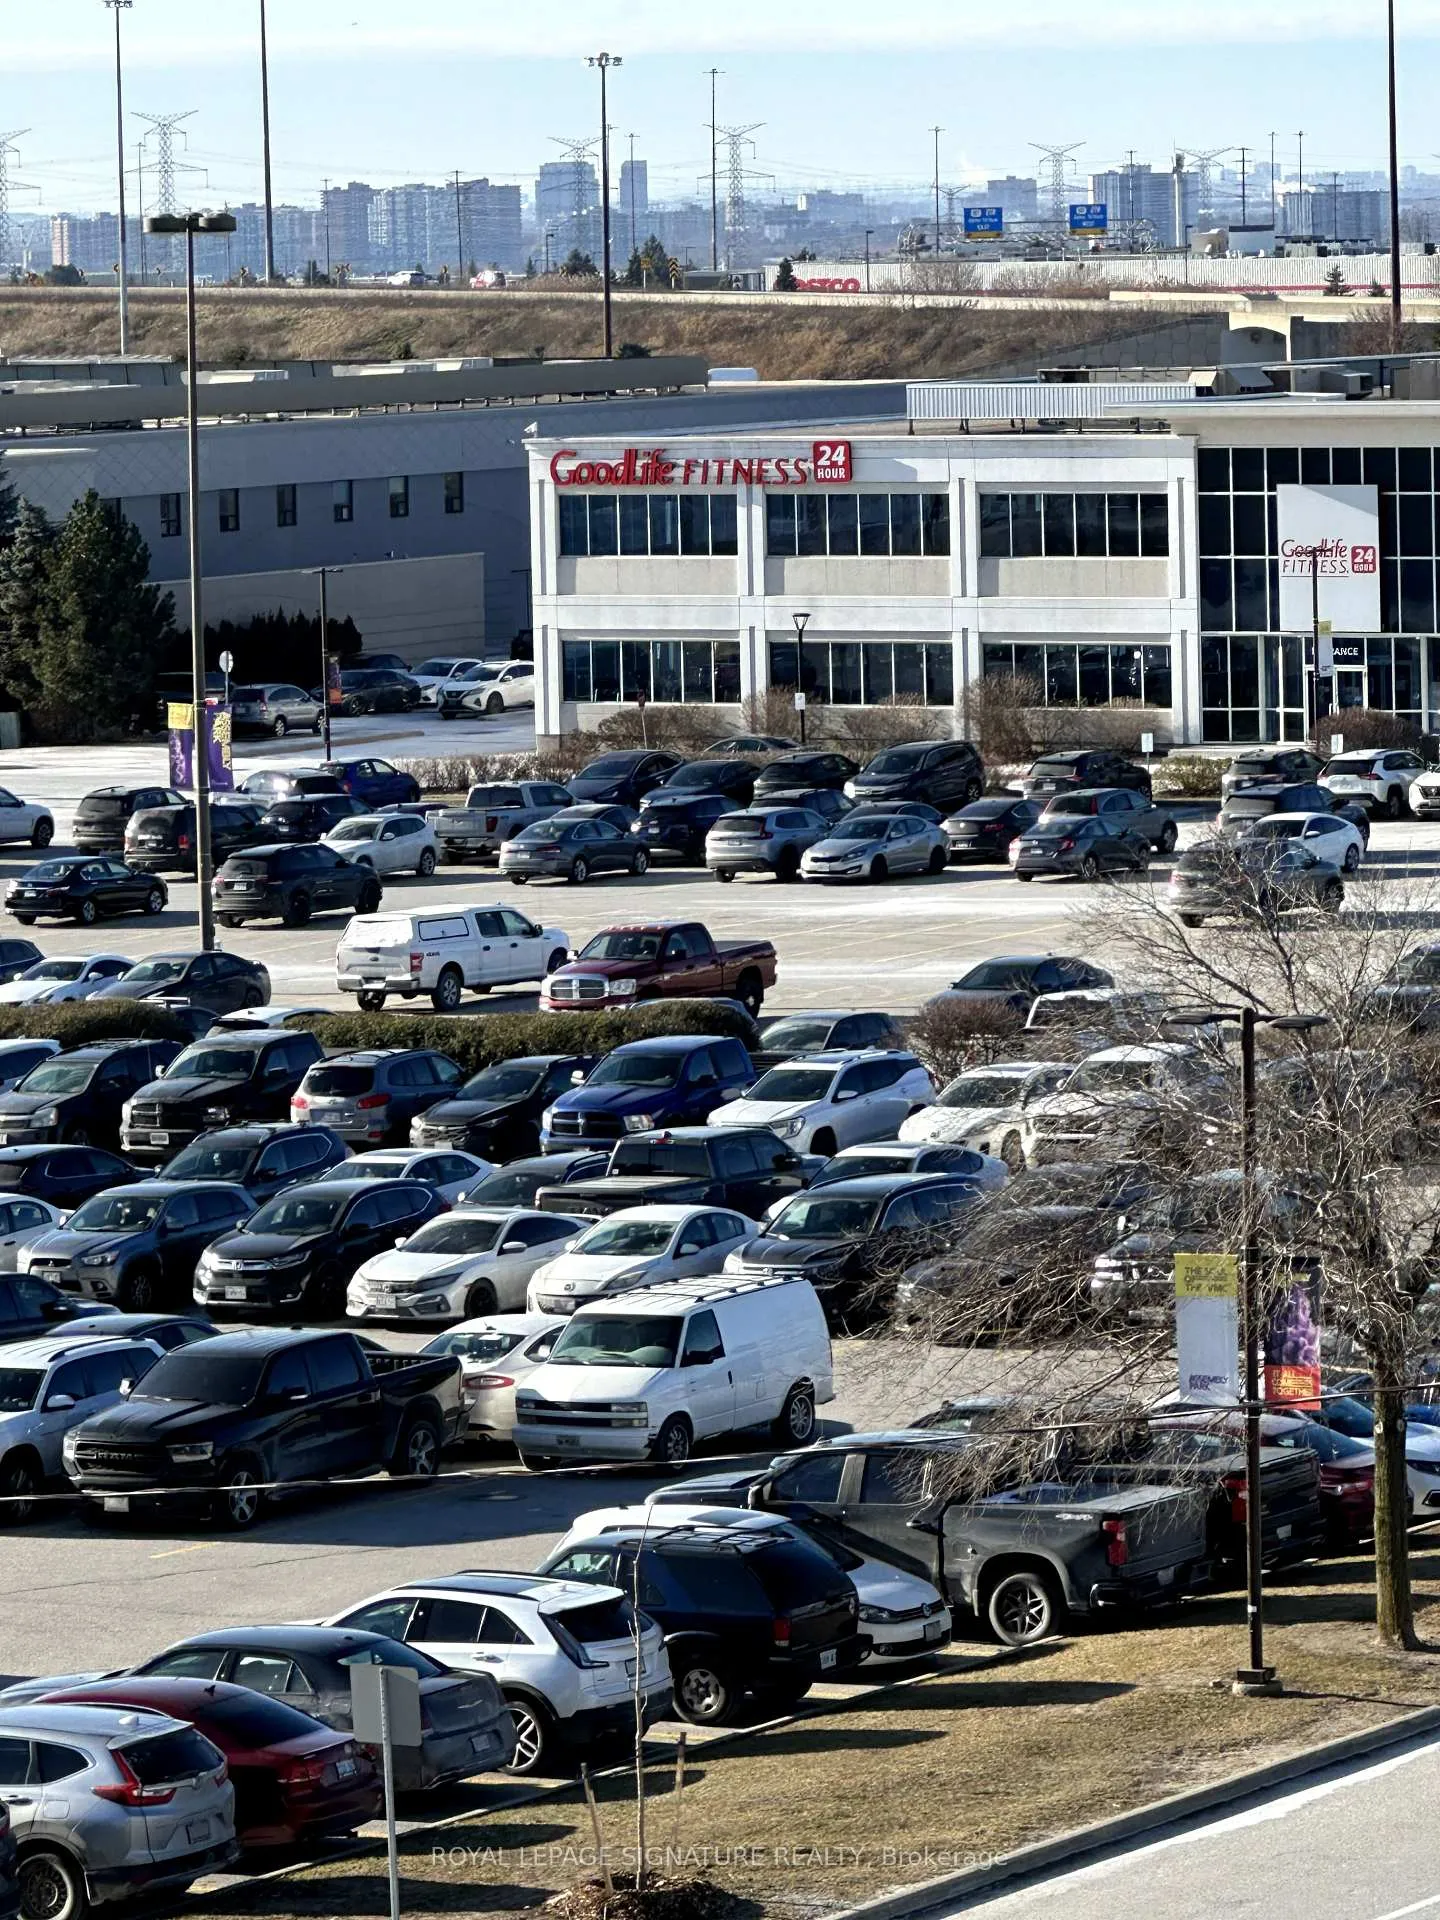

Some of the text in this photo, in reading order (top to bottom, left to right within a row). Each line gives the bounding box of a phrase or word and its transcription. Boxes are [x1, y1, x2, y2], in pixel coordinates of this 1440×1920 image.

[817, 445, 846, 465] 24
[550, 448, 808, 486] GoodLife FITNESS
[817, 467, 846, 479] HOUR
[1354, 548, 1374, 562] 24
[1353, 563, 1374, 572] HOUR
